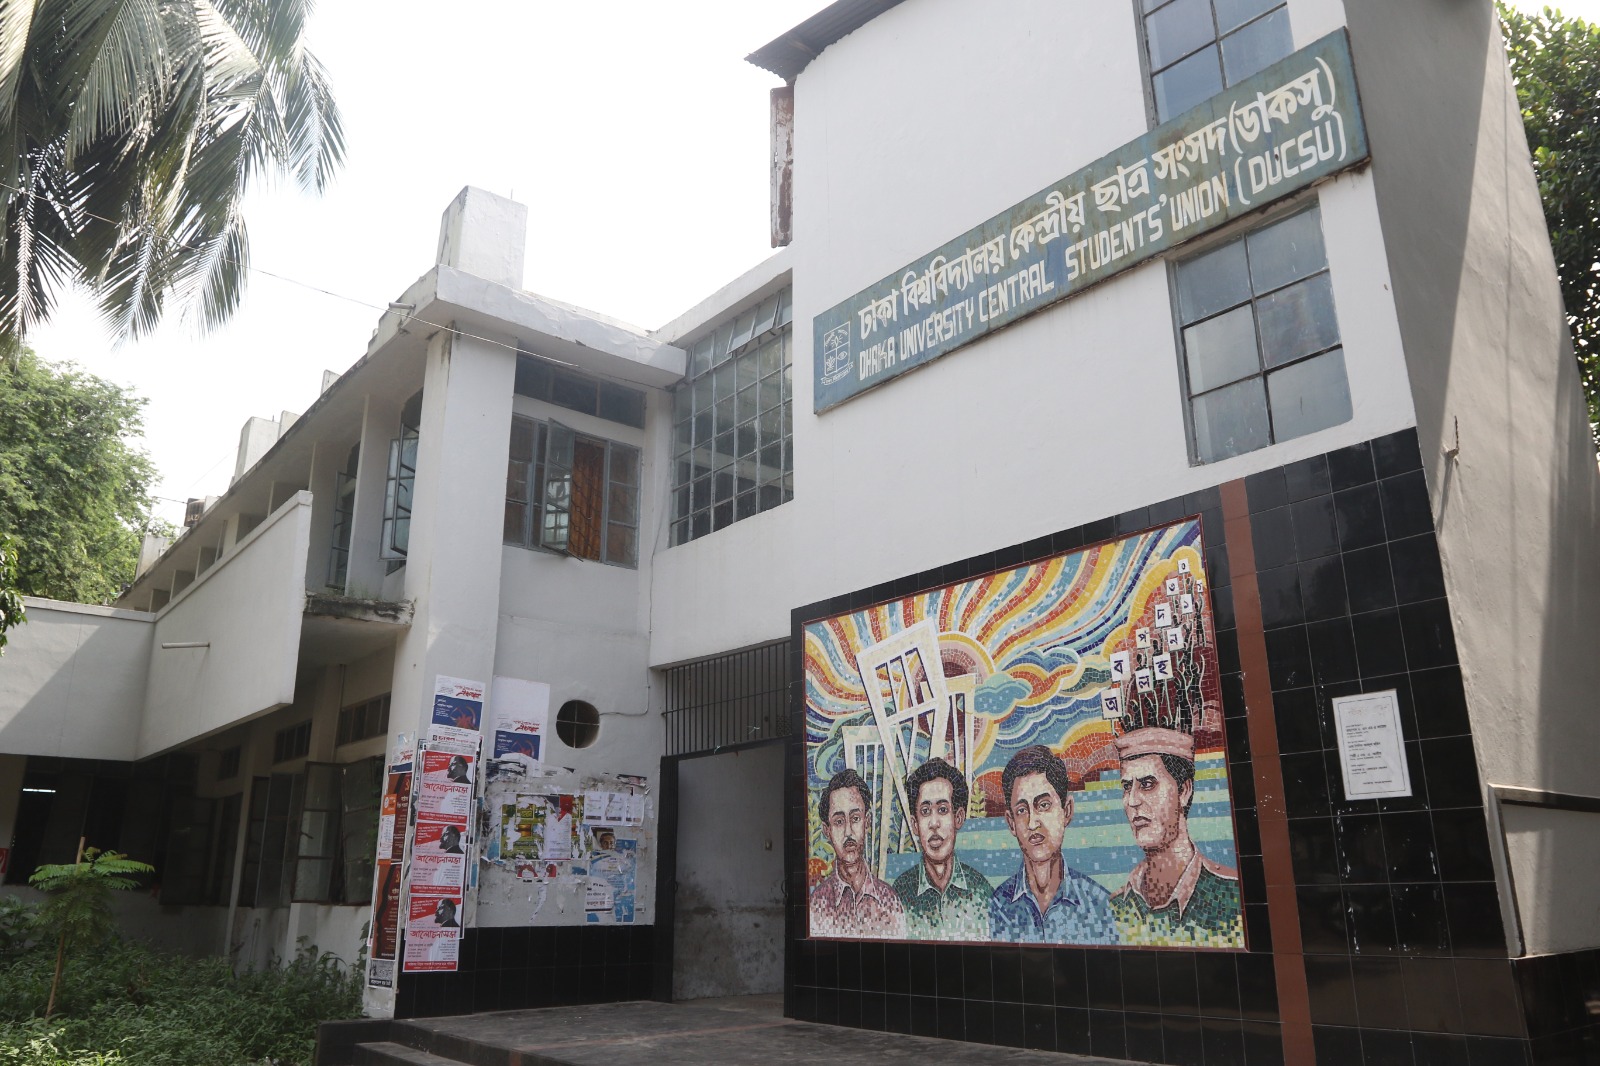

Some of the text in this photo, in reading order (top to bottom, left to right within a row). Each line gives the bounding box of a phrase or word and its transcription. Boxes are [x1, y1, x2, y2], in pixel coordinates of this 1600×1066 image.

[858, 289, 899, 340] ঢাকা
[901, 234, 1006, 316] বিশ্ববিদ্যালয়
[1009, 190, 1086, 260] কেন্দ্রীয়
[1090, 158, 1151, 212] ছাত্র
[860, 336, 895, 381] DHAKA
[900, 296, 975, 361] UNIVERSITY
[979, 260, 1055, 323] CENTRAL
[1170, 171, 1230, 232] UNION
[1234, 111, 1347, 206] (DUCSU)
